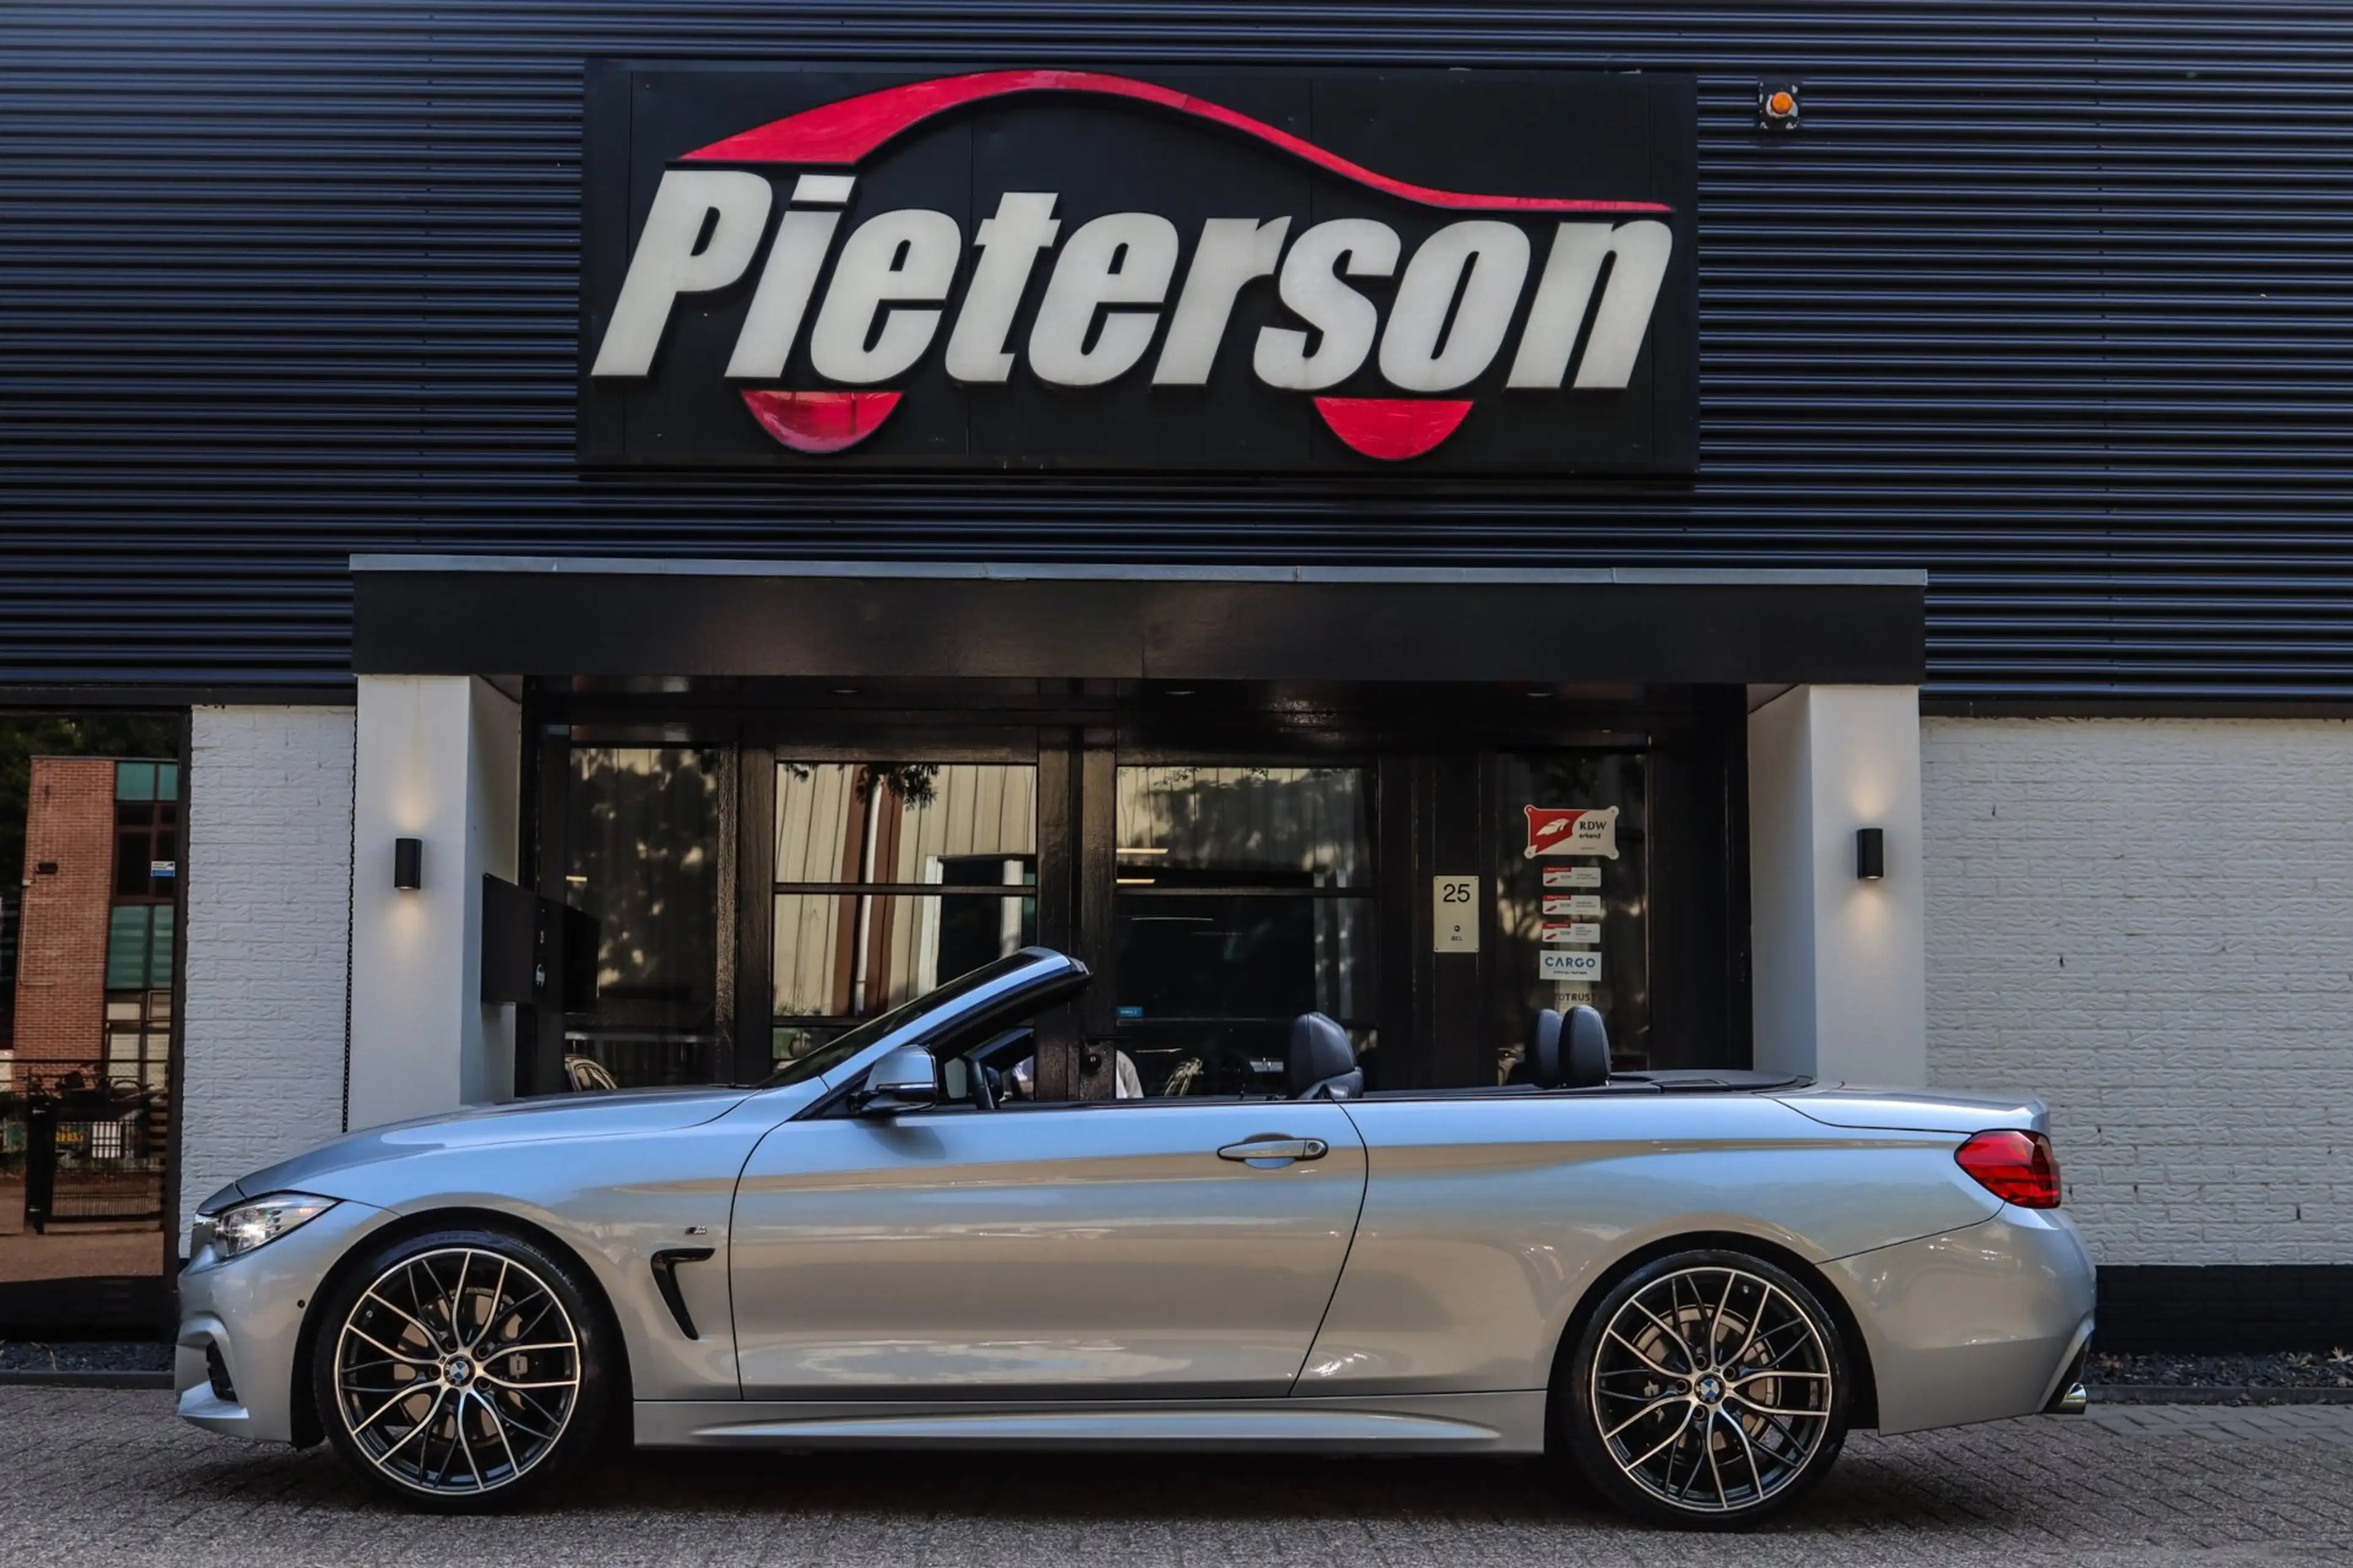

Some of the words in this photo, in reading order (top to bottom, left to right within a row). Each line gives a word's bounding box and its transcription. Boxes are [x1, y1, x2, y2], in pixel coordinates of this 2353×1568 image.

[591, 170, 1673, 392] Pieterson
[1579, 821, 1607, 830] RDW
[1443, 884, 1470, 903] 25
[1545, 956, 1596, 968] CARGO
